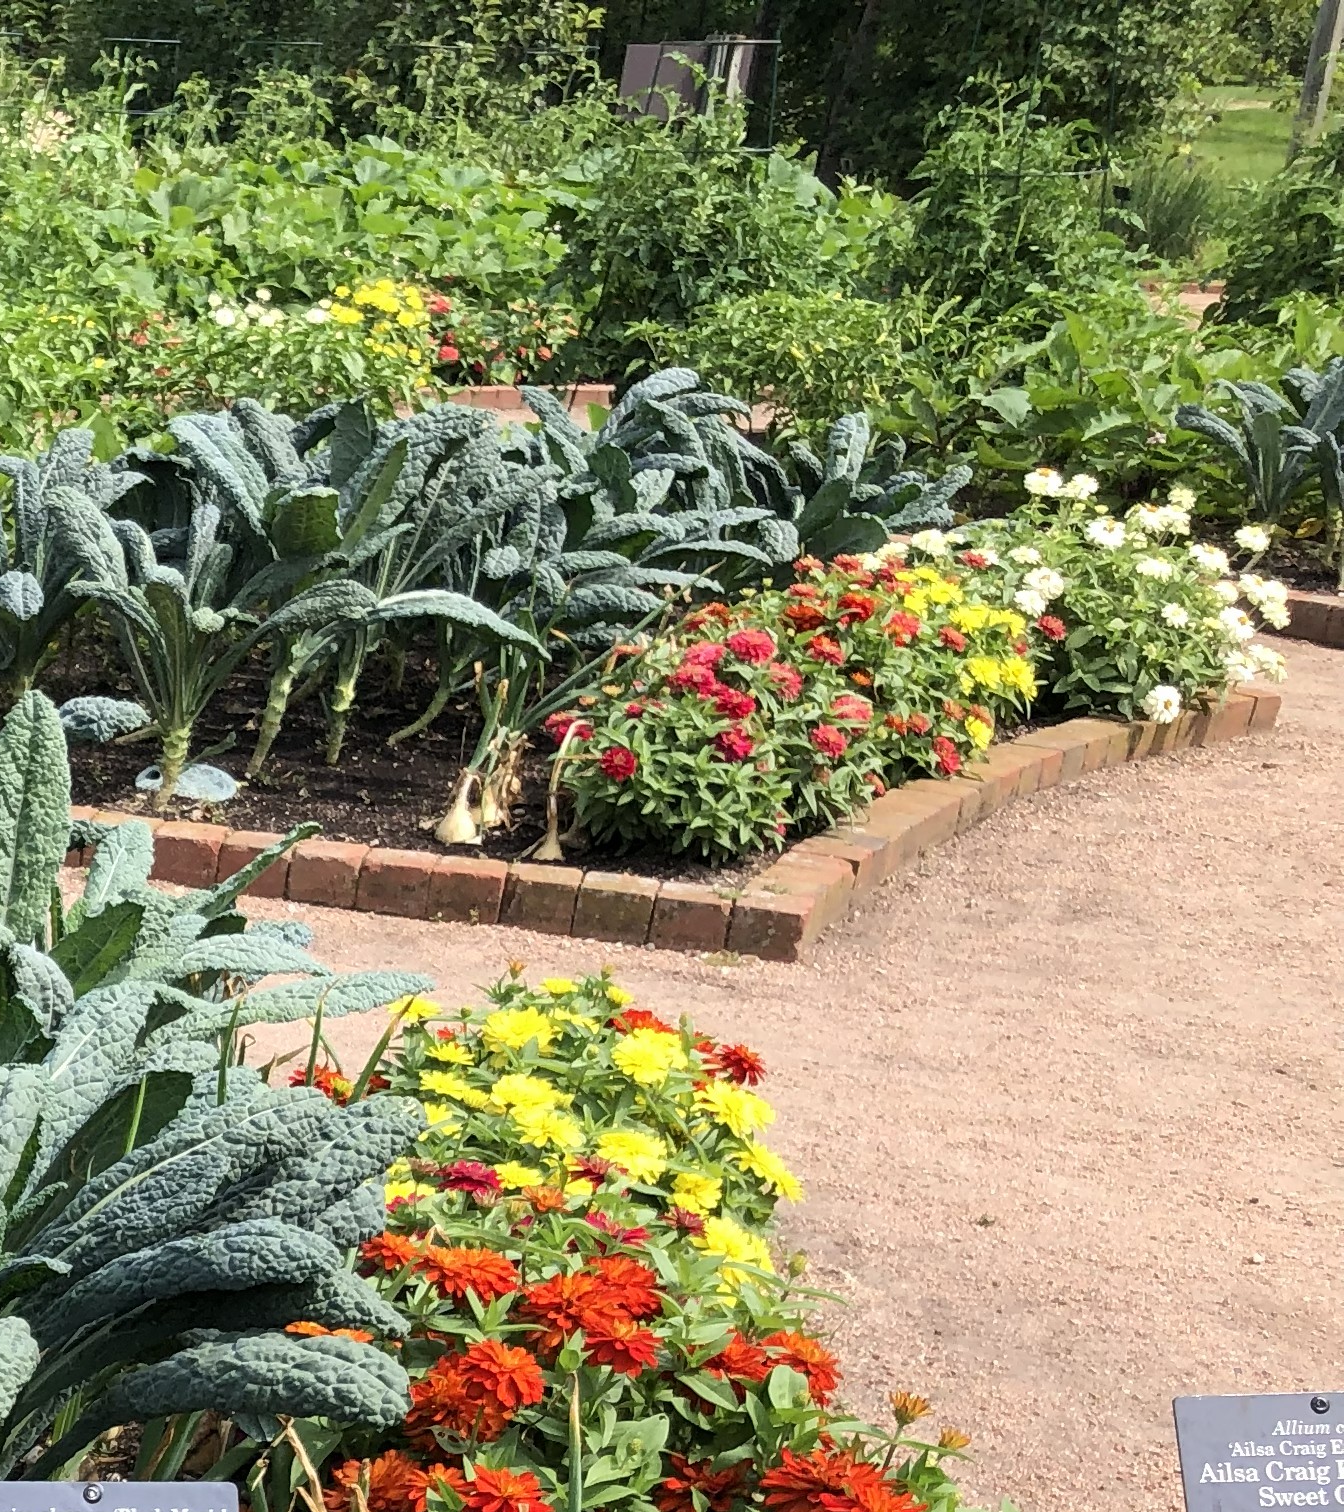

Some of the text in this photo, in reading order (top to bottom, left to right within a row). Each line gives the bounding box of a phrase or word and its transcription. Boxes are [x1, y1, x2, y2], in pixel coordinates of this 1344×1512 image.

[1271, 1420, 1330, 1436] Allium
[1228, 1441, 1276, 1457] ‘Ailsa
[1279, 1440, 1327, 1458] Craig
[1199, 1461, 1261, 1484] Ailsa
[1265, 1461, 1332, 1486] Craig
[1258, 1486, 1330, 1507] Sweet
